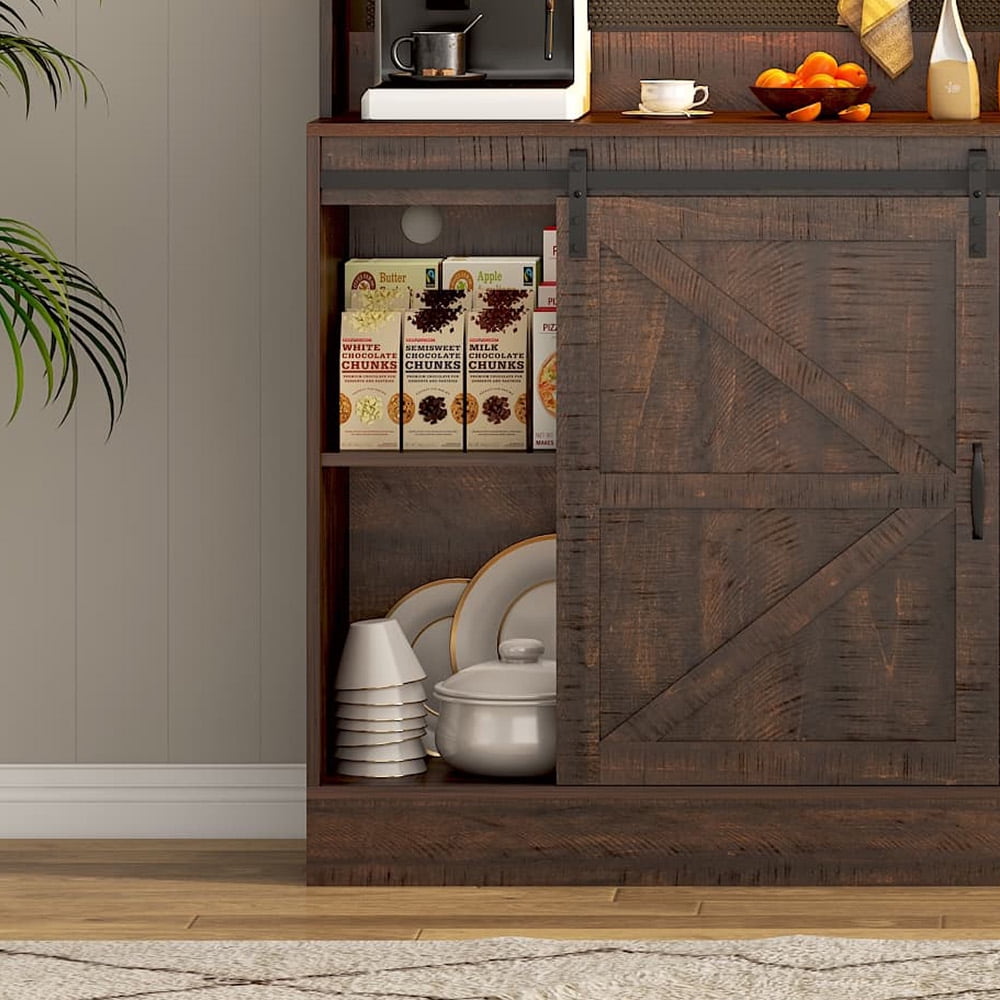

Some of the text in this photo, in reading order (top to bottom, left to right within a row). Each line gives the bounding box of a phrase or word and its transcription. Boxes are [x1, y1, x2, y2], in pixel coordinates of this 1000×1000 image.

[380, 272, 407, 283] Butter
[477, 271, 502, 284] Apple
[342, 361, 397, 369] CHUNKS
[405, 361, 461, 369] CHUNKS
[469, 361, 524, 369] CHUNKS
